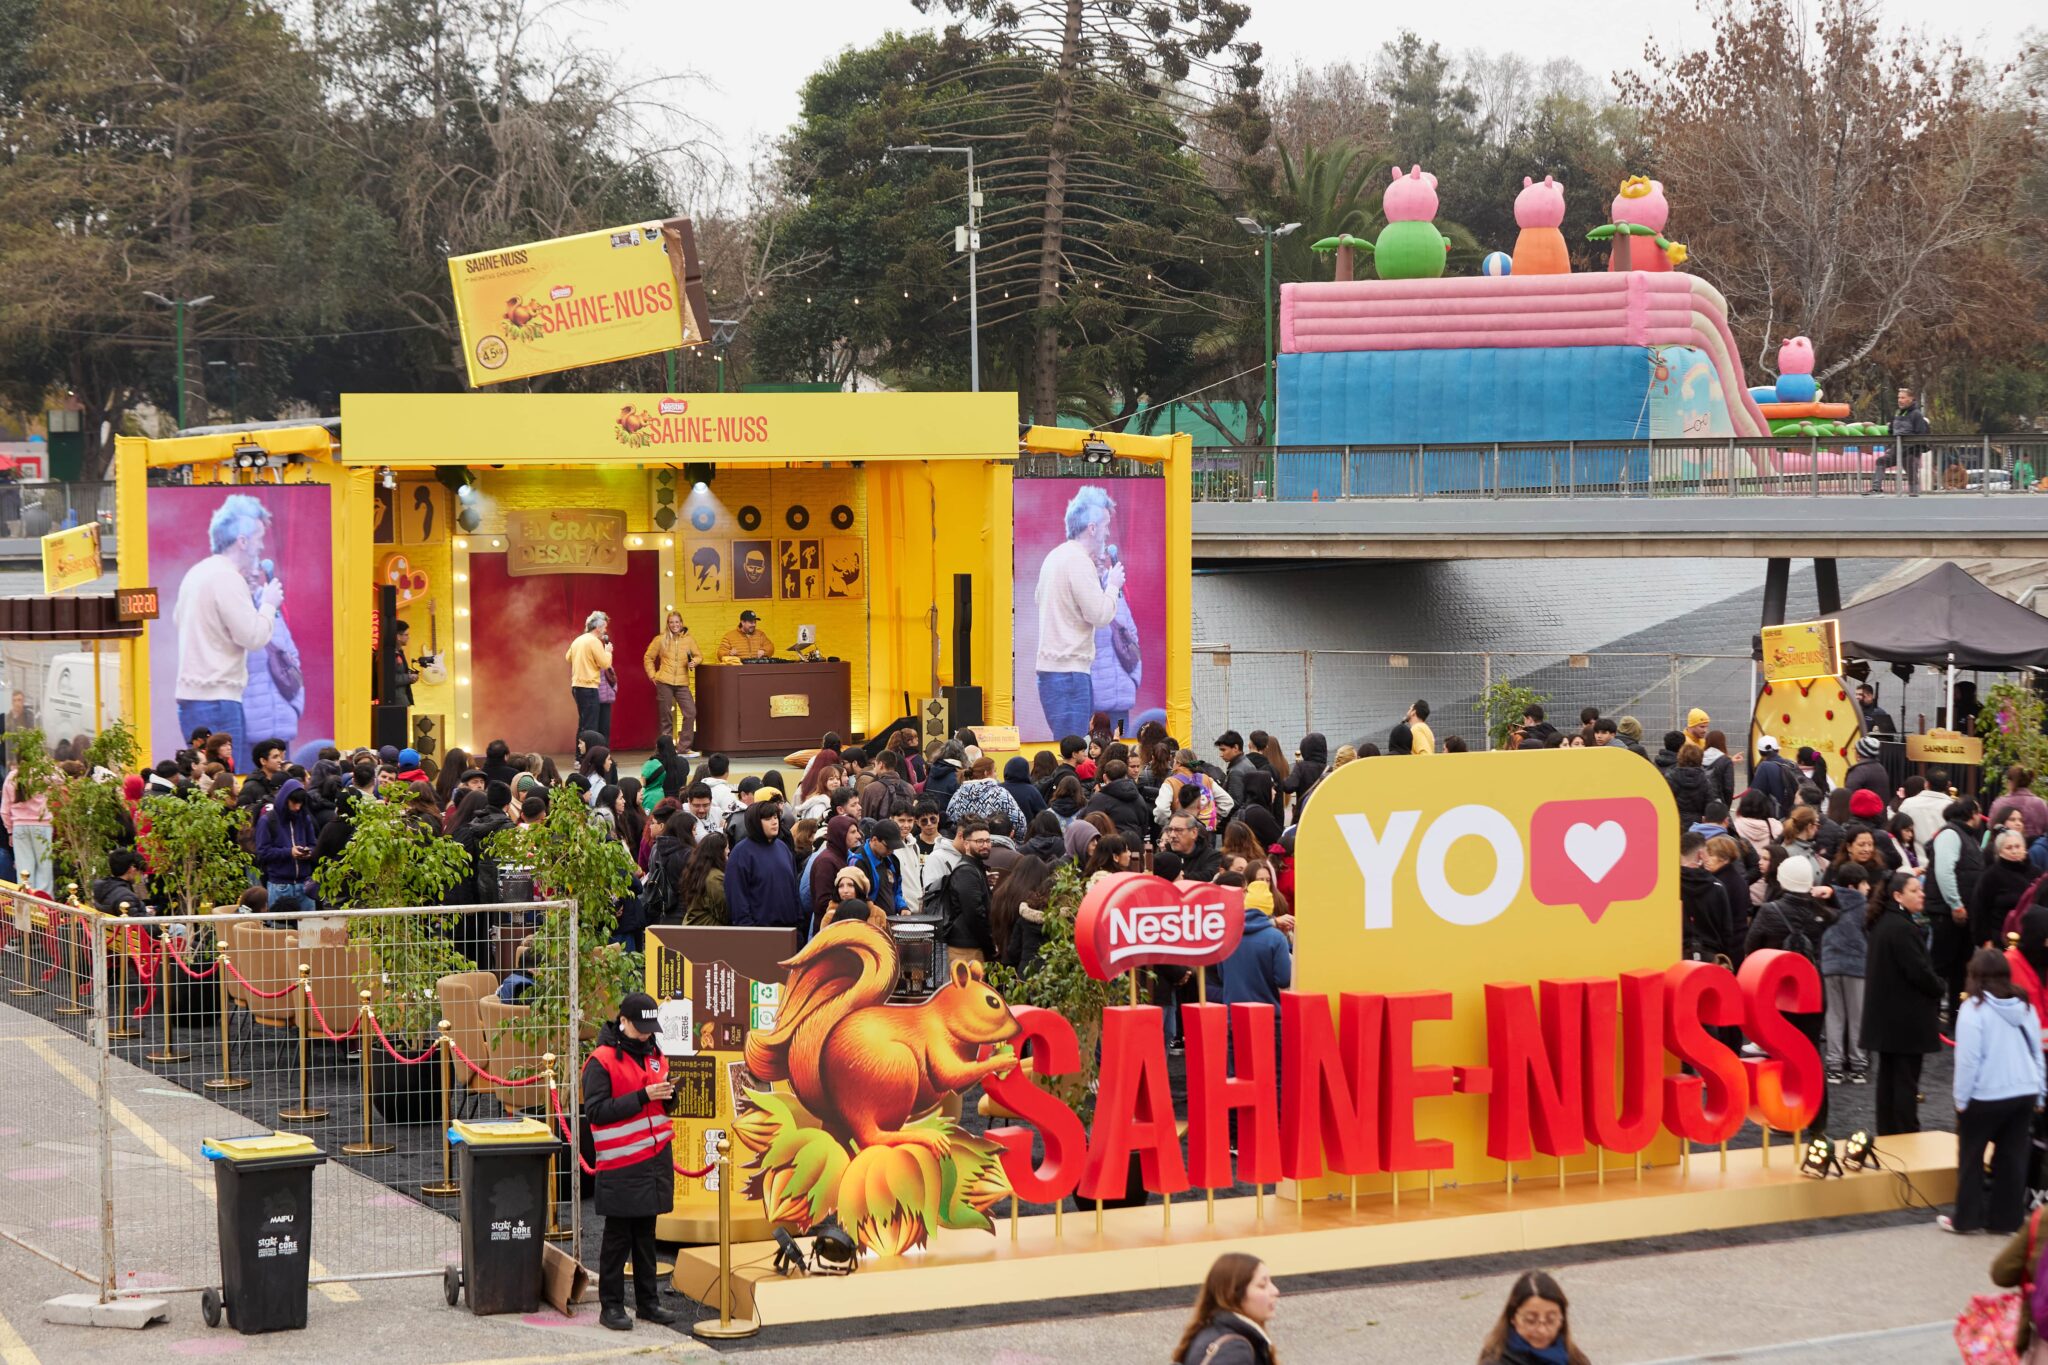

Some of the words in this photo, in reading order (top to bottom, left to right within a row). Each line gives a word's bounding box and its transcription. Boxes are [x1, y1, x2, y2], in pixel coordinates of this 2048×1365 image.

[540, 282, 673, 333] SAHNE-NUSS
[650, 415, 768, 444] SAHNE-NUSS
[1334, 803, 1525, 930] YO
[1109, 902, 1226, 946] Nestlé
[977, 948, 1824, 1204] SAHNE-NUSS
[278, 1241, 298, 1249] CORE
[512, 1226, 531, 1234] CORE
